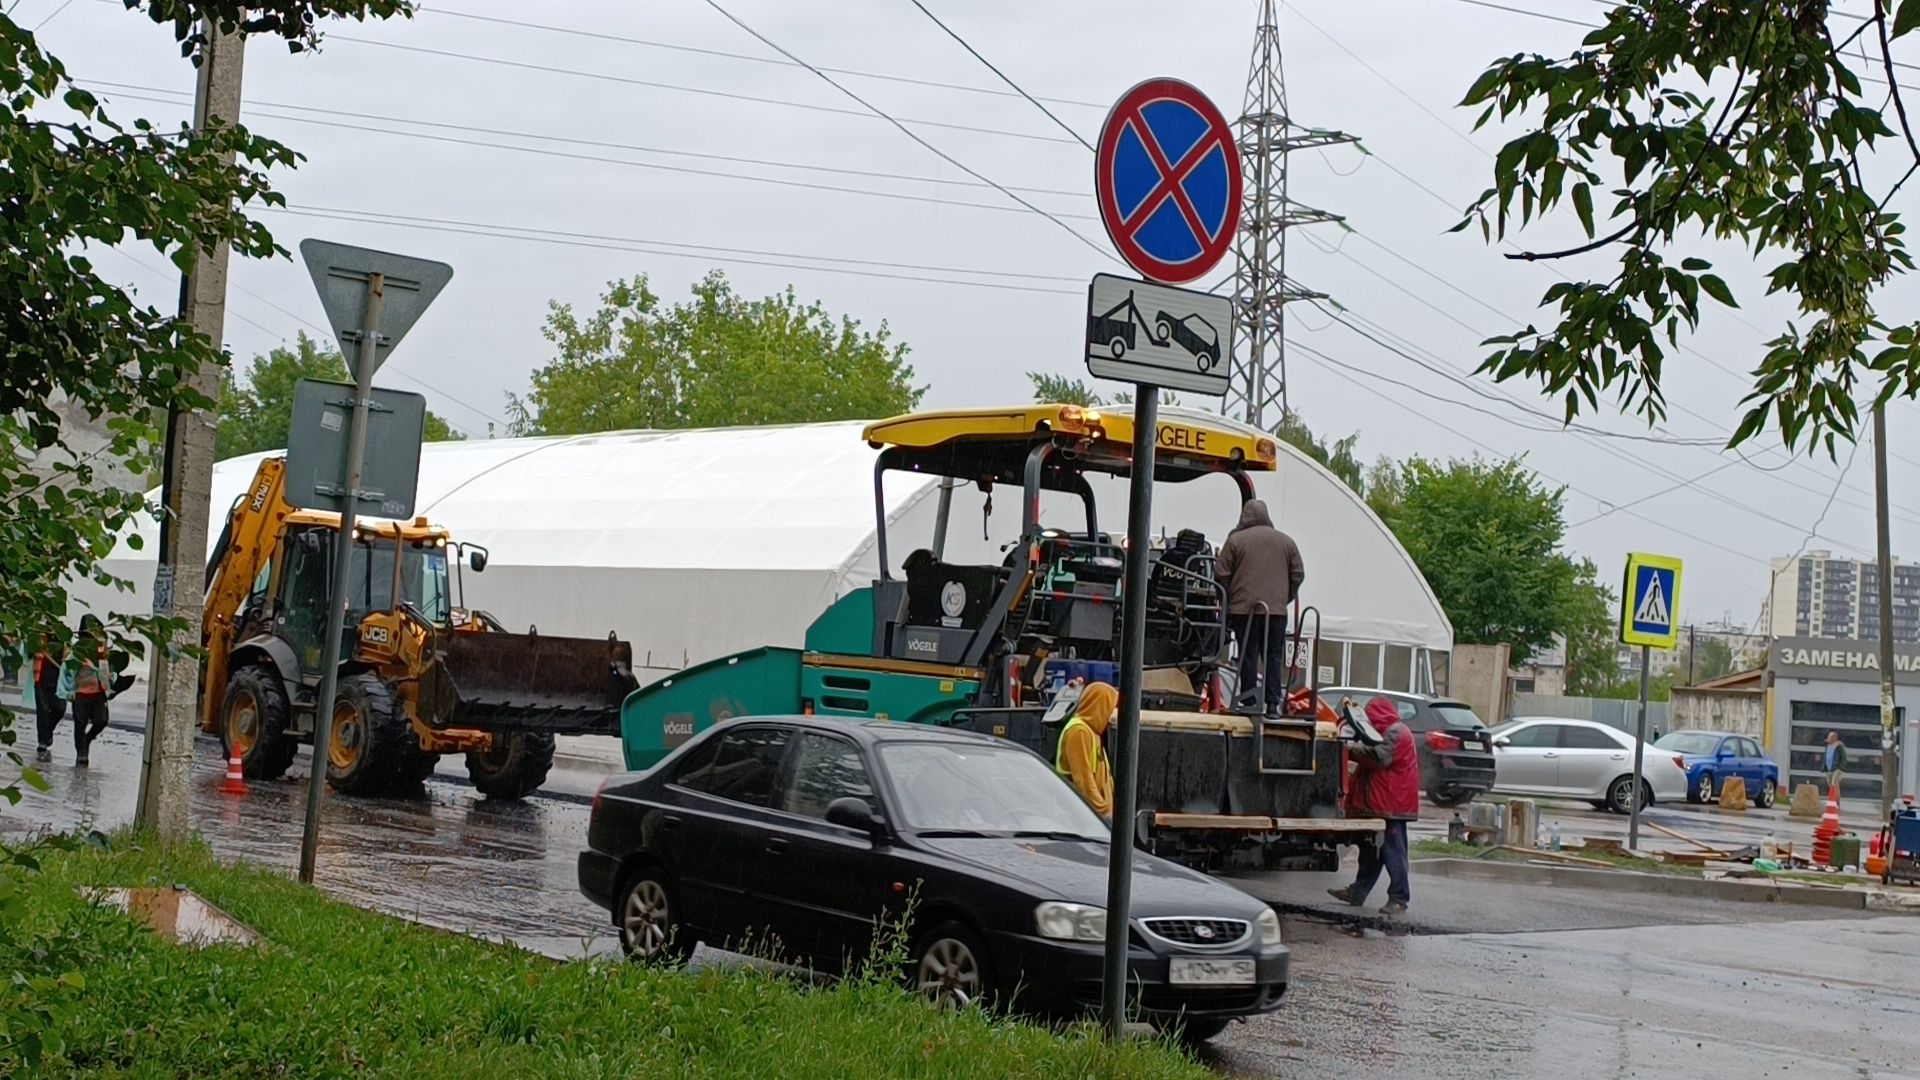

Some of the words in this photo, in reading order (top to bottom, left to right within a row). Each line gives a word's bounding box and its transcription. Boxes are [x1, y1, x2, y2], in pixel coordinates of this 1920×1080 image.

[1155, 425, 1206, 450] GELE
[365, 626, 388, 642] JCB
[907, 638, 938, 652] VÖGELE
[1780, 648, 1880, 670] ЗАМЕНА
[663, 721, 694, 735] VÖGELE
